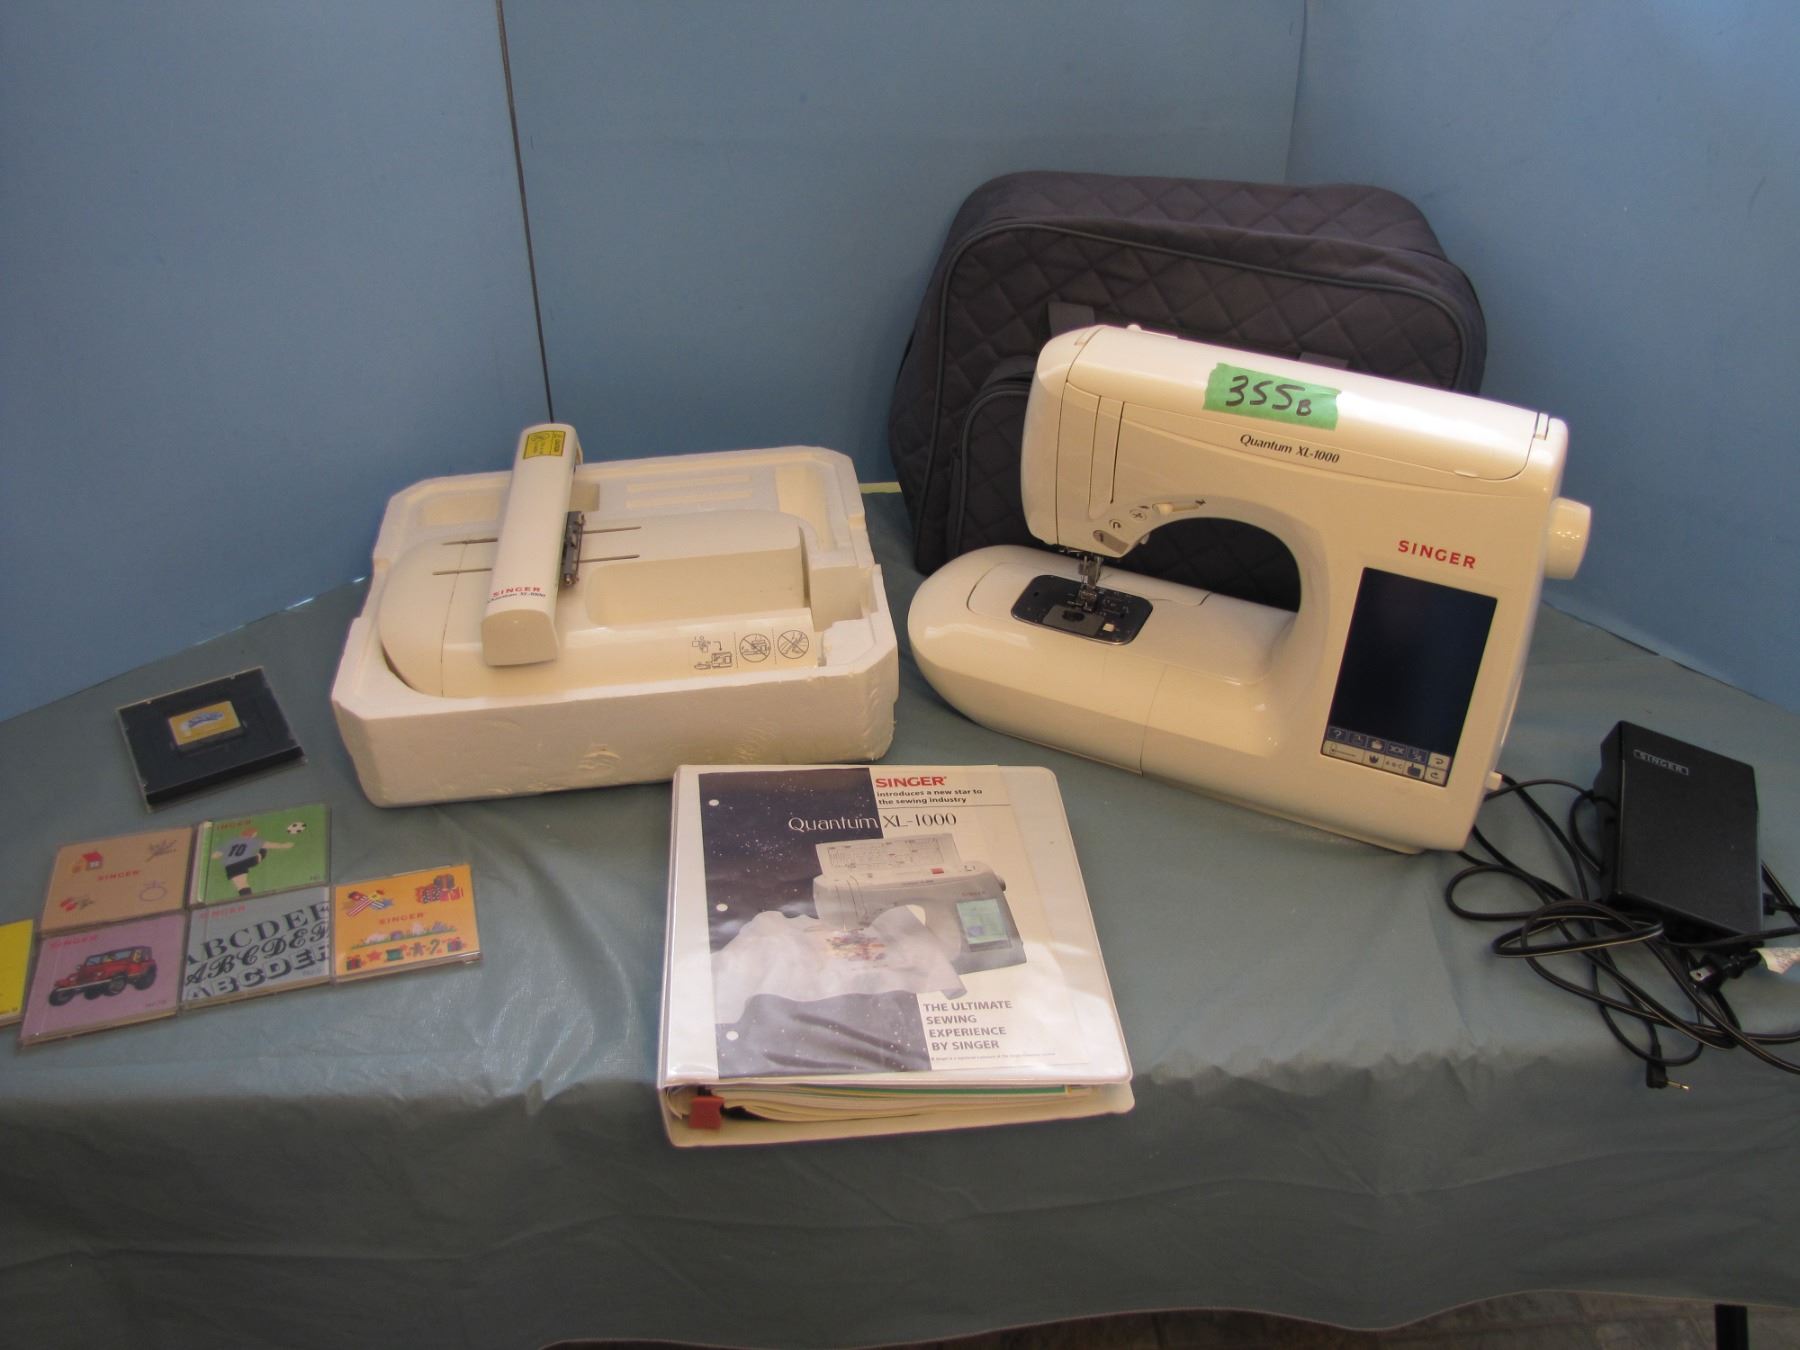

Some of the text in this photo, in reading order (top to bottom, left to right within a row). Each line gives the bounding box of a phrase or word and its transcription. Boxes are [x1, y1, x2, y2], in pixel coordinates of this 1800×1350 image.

[1239, 433, 1341, 464] Quantum XL-1000
[1397, 540, 1477, 569] SINGER
[492, 586, 541, 597] SINGER
[896, 797, 928, 805] sewing
[930, 796, 967, 804] industry
[788, 812, 957, 833] Quantum XL-1000
[228, 843, 248, 857] 10
[379, 912, 424, 925] SINGER
[923, 1000, 1013, 1012] THE ULTIMATE
[926, 1014, 977, 1025] SEWING
[929, 1026, 1007, 1038] EXPERIENCE
[932, 1039, 1000, 1052] BY SINGER
